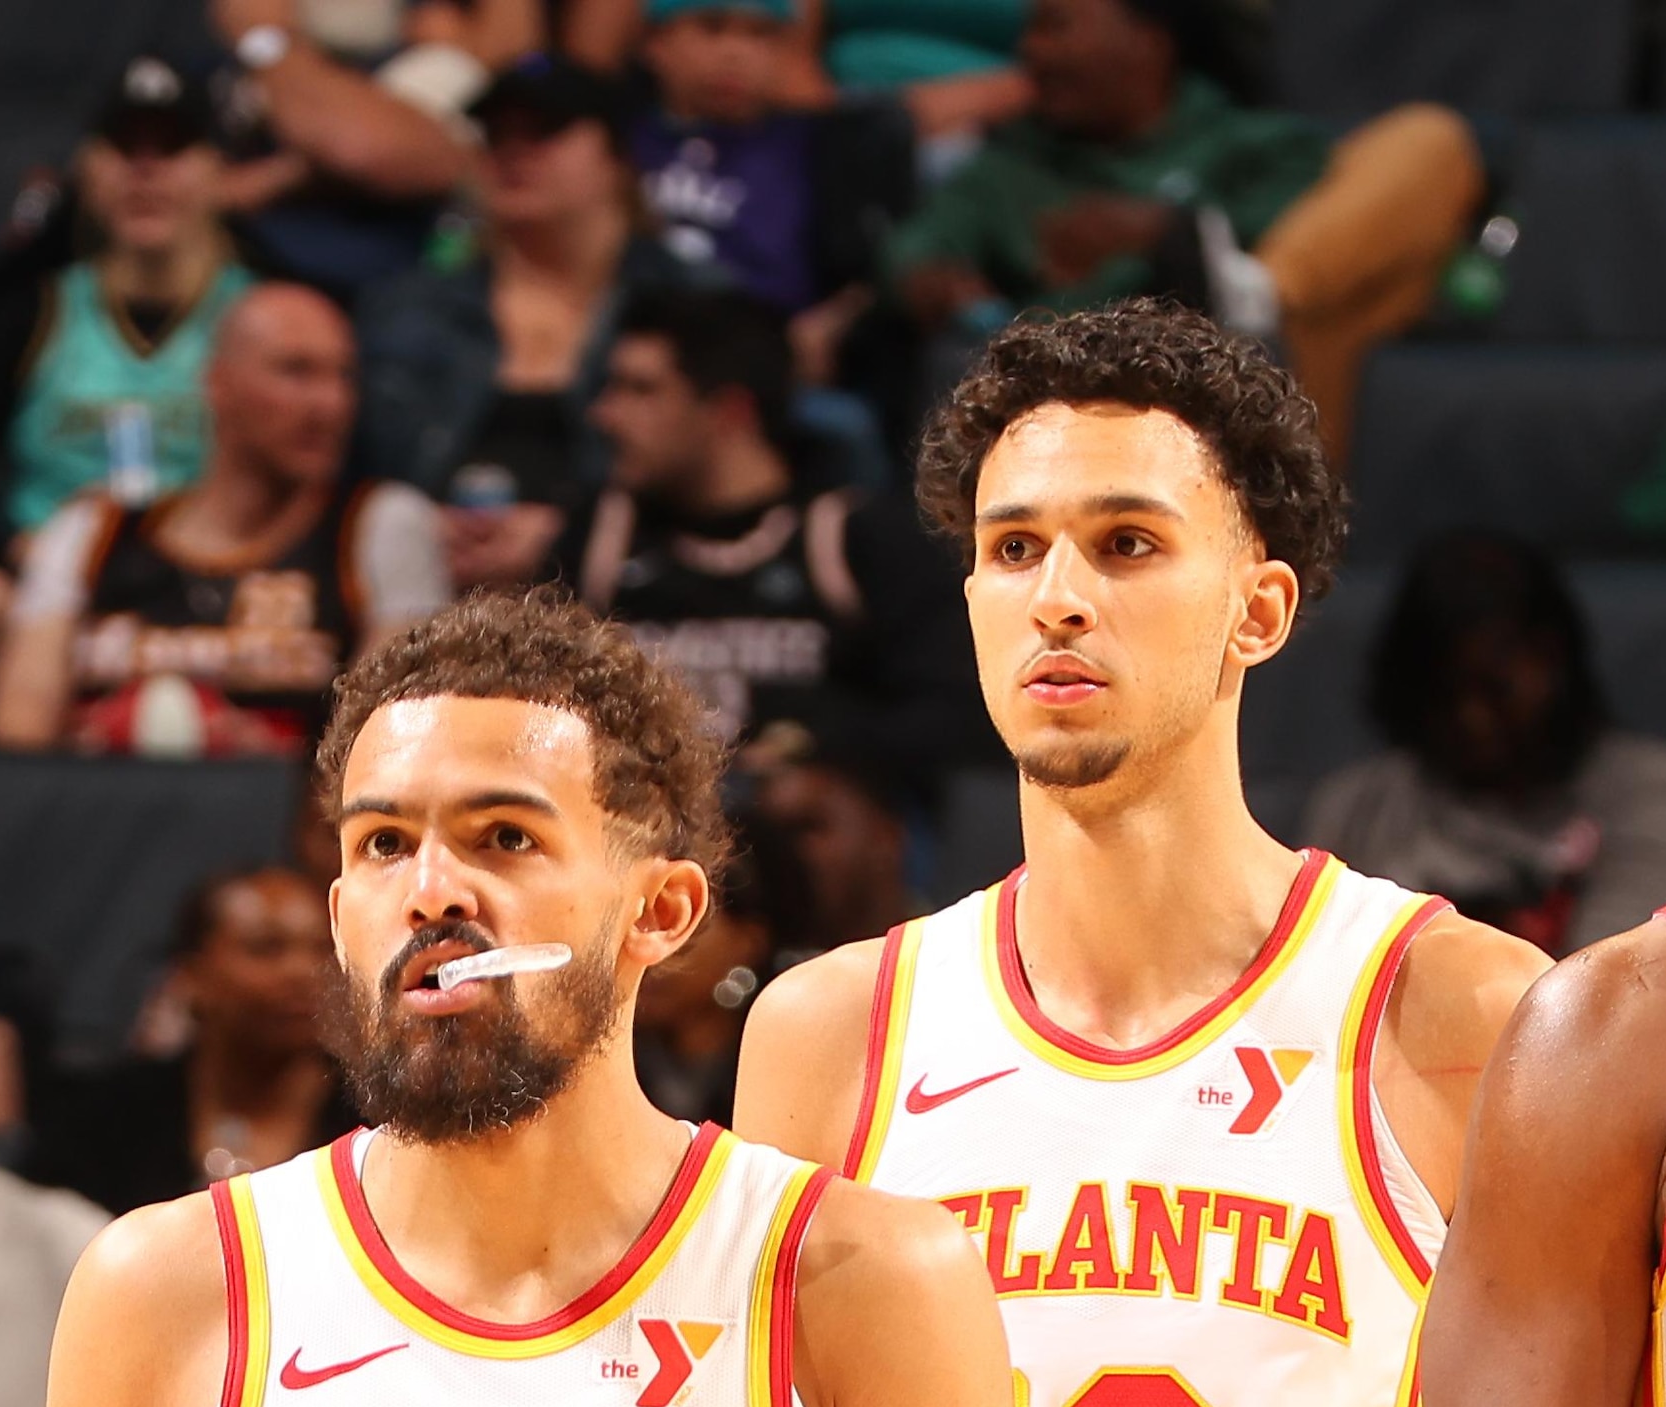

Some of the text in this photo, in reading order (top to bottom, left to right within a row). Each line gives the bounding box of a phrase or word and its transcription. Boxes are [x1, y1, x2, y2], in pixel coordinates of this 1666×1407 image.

[1198, 1086, 1233, 1105] the
[935, 1181, 1353, 1345] LANTA
[601, 1359, 639, 1379] the
